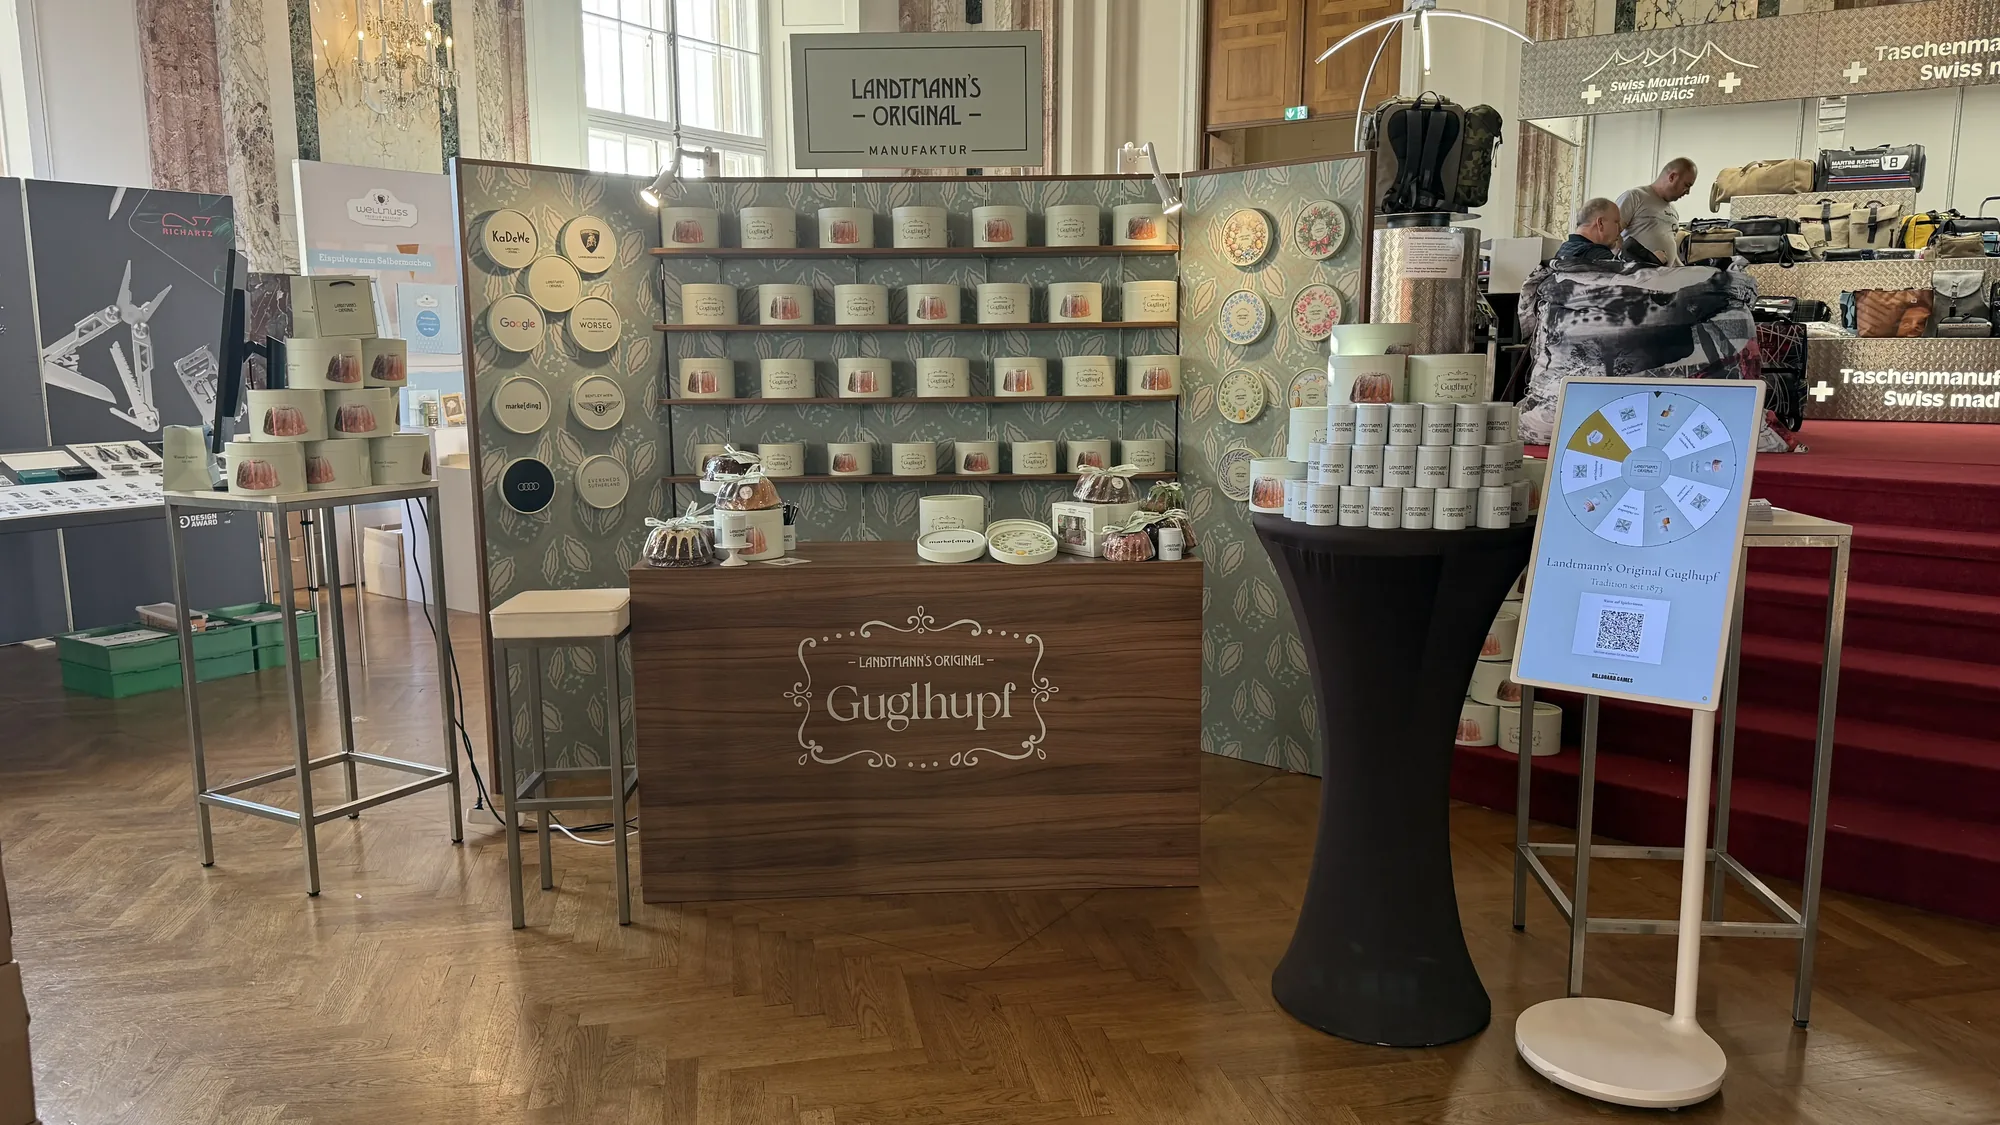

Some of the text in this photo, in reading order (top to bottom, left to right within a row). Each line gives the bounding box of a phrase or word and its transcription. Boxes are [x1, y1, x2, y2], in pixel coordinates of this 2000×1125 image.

[1921, 61, 1982, 80] Swiss
[852, 74, 981, 99] LANDTMANN'S
[1610, 74, 1710, 92] Swiss Mountain
[1622, 88, 1695, 104] HÄND BÄGS
[873, 105, 961, 126] ORIGINAL
[869, 145, 967, 155] MANUFAKTUR
[1890, 157, 1898, 168] 8
[356, 205, 408, 216] wellnuss
[163, 228, 213, 237] RICHARTZ
[492, 230, 530, 243] KaDeWe
[318, 253, 358, 264] Eispulver
[377, 257, 432, 267] Selbermachen
[500, 317, 535, 330] Google
[1440, 382, 1473, 392] Guglhupf
[1884, 390, 1944, 407] Swiss
[505, 401, 542, 411] marke[ding]
[191, 512, 218, 522] DESIGN
[191, 518, 218, 527] AWARD
[1546, 557, 1720, 584] Landtmann's Original Guglhupf
[1591, 578, 1664, 594] Tradition seit 1873
[859, 654, 984, 668] LANDTMANN'S ORIGINAL
[1592, 673, 1616, 681] BILLBOARD
[1617, 675, 1633, 683] GAMES
[827, 682, 1016, 731] Guglhupf
